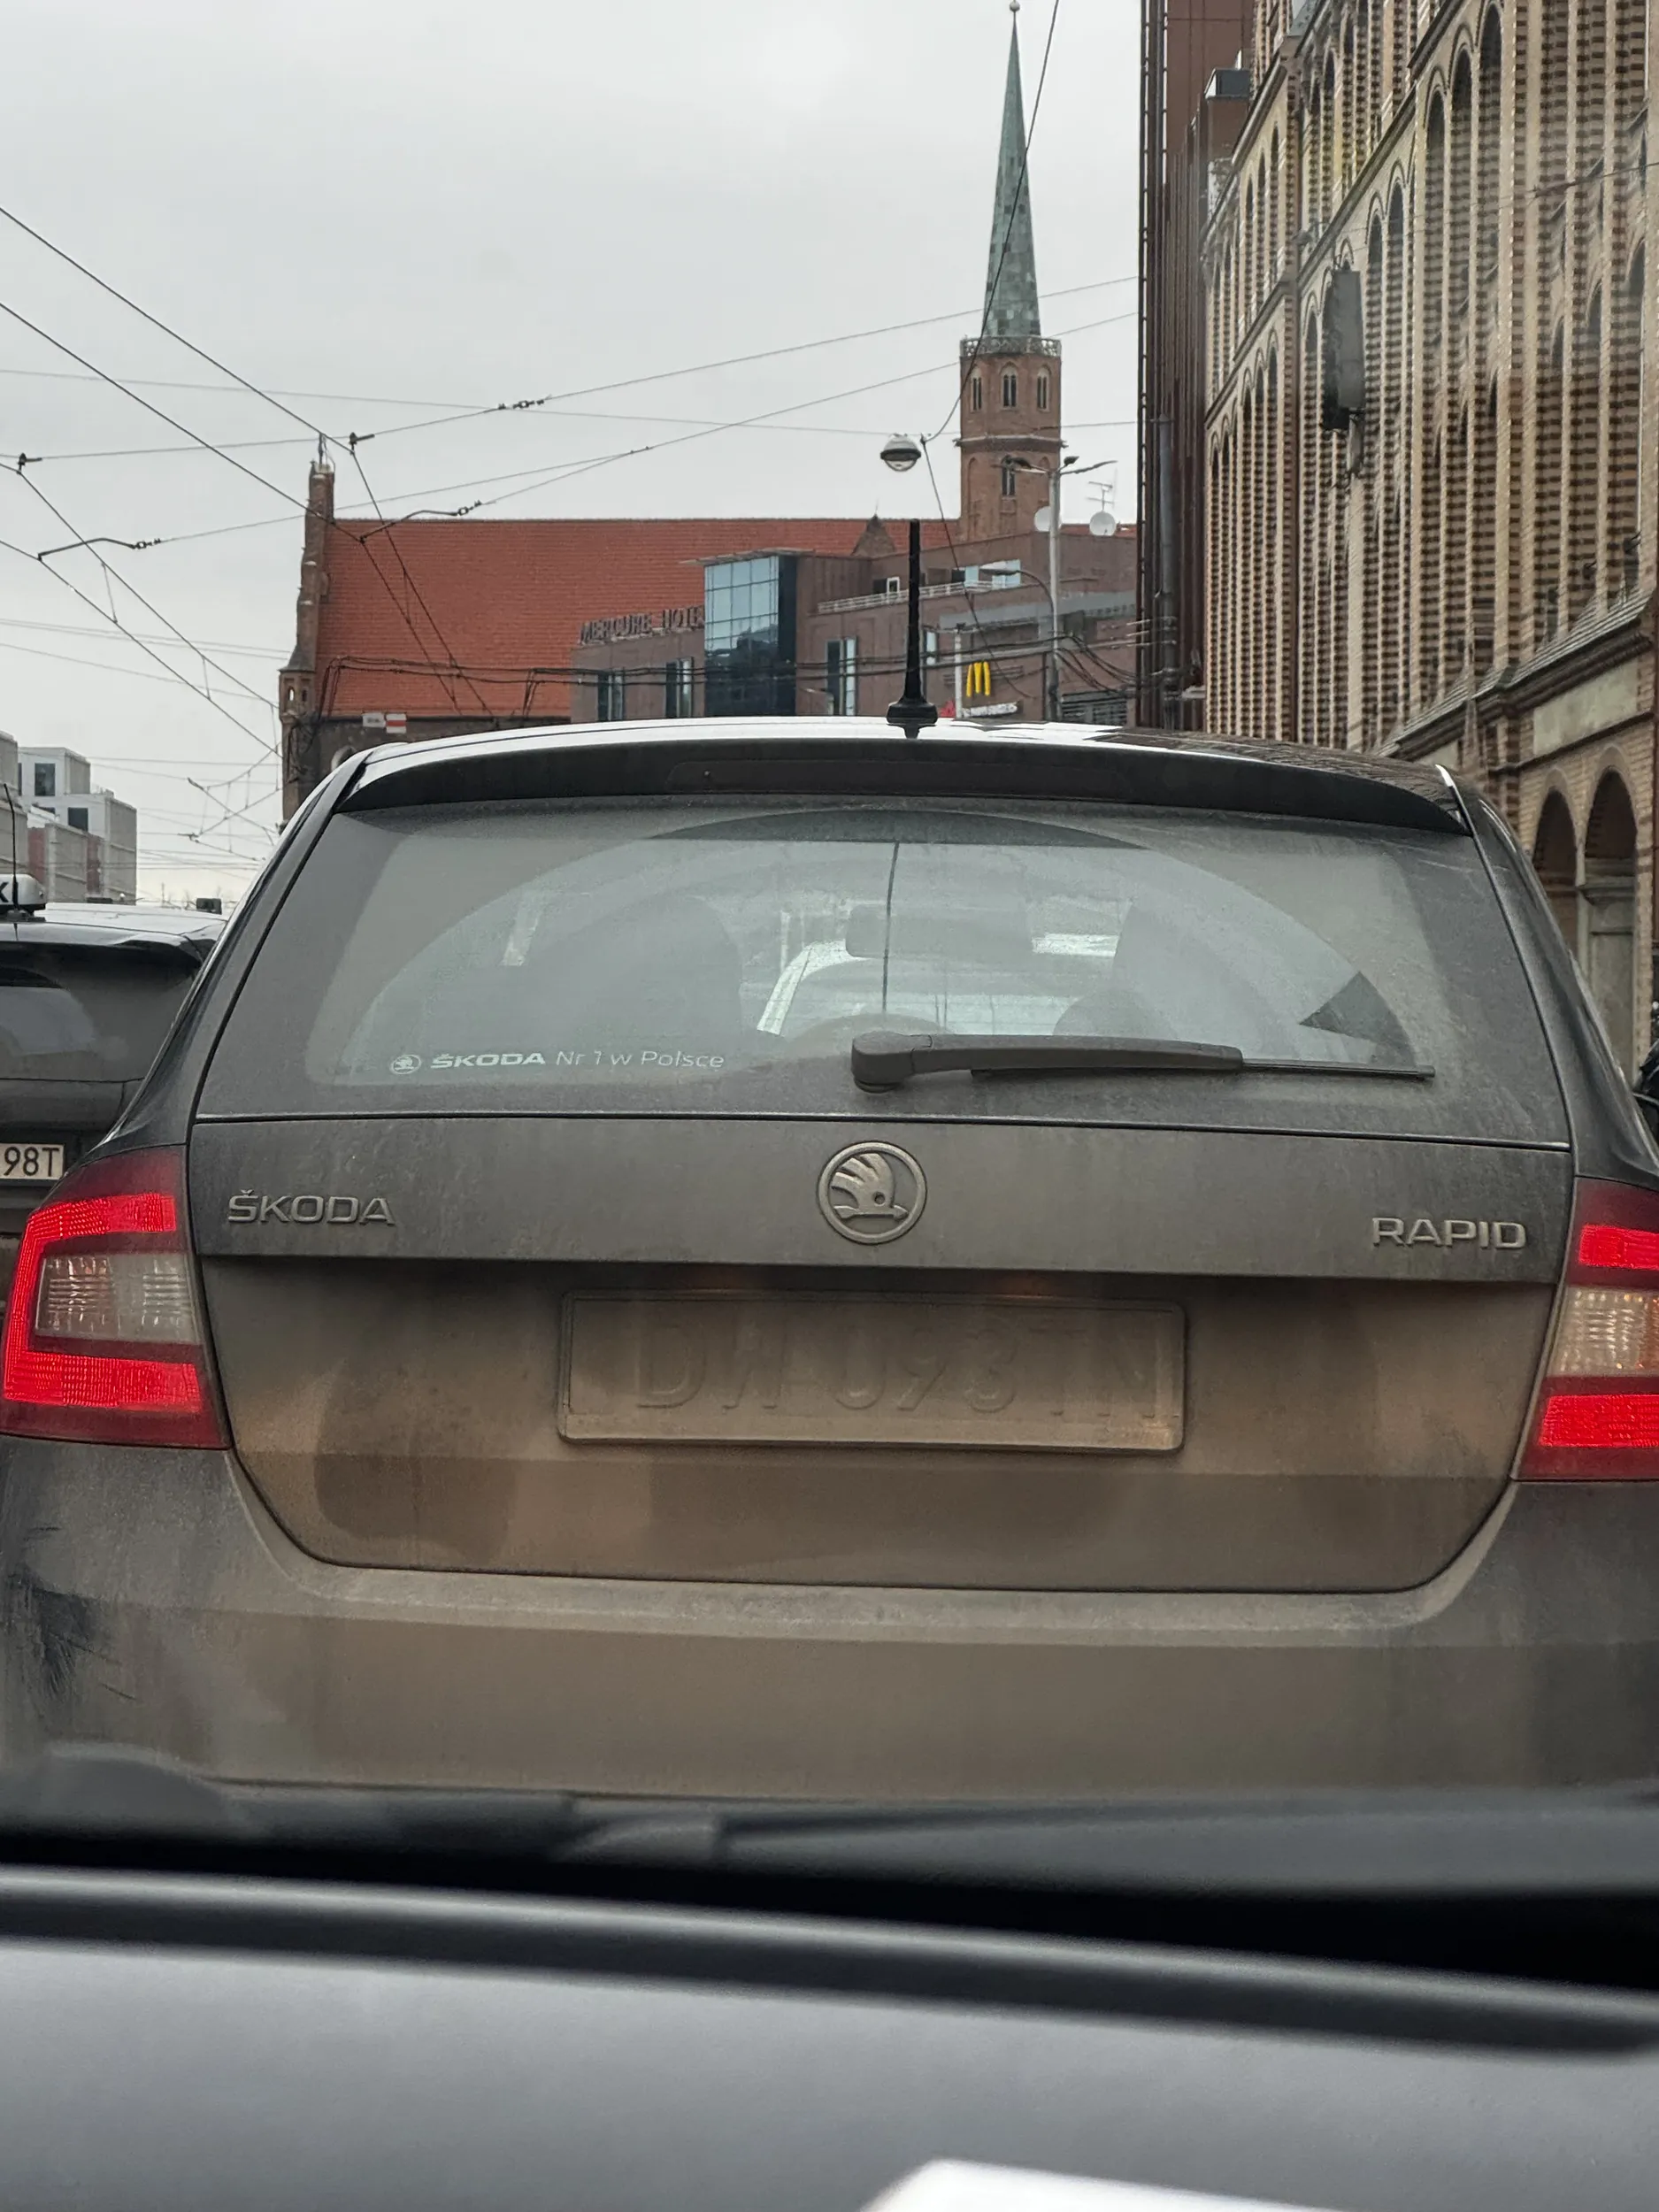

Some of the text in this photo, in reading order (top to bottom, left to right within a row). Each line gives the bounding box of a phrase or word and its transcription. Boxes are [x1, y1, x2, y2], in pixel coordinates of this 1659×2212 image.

[556, 1050, 585, 1065] Nr
[594, 1050, 603, 1065] 1
[611, 1054, 633, 1065] w
[641, 1050, 725, 1068] Polsce
[227, 1188, 396, 1225] ŠKODA
[1371, 1217, 1527, 1249] RAPID
